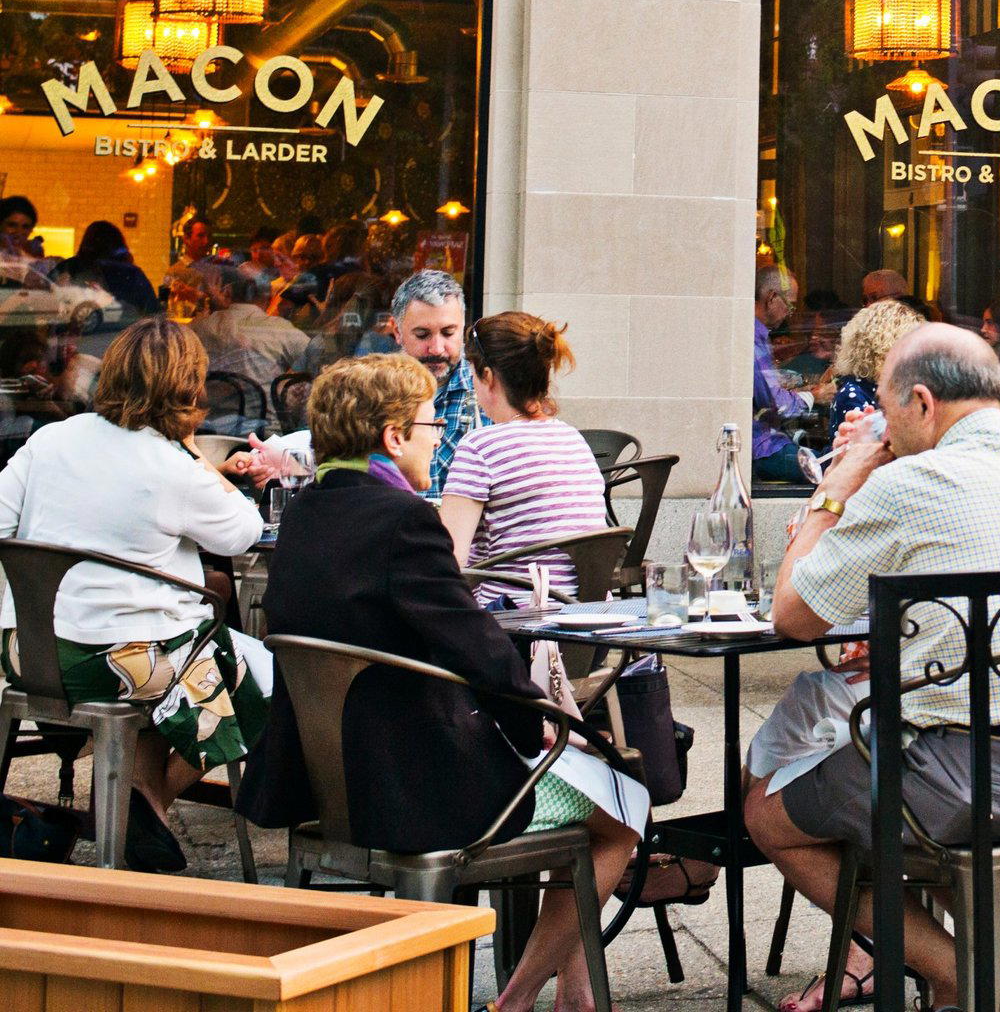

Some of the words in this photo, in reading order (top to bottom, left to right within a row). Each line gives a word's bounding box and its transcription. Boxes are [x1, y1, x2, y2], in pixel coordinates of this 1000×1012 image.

[41, 45, 386, 148] MACON
[198, 138, 217, 160] &
[225, 138, 328, 164] LARDER
[978, 165, 995, 185] &
